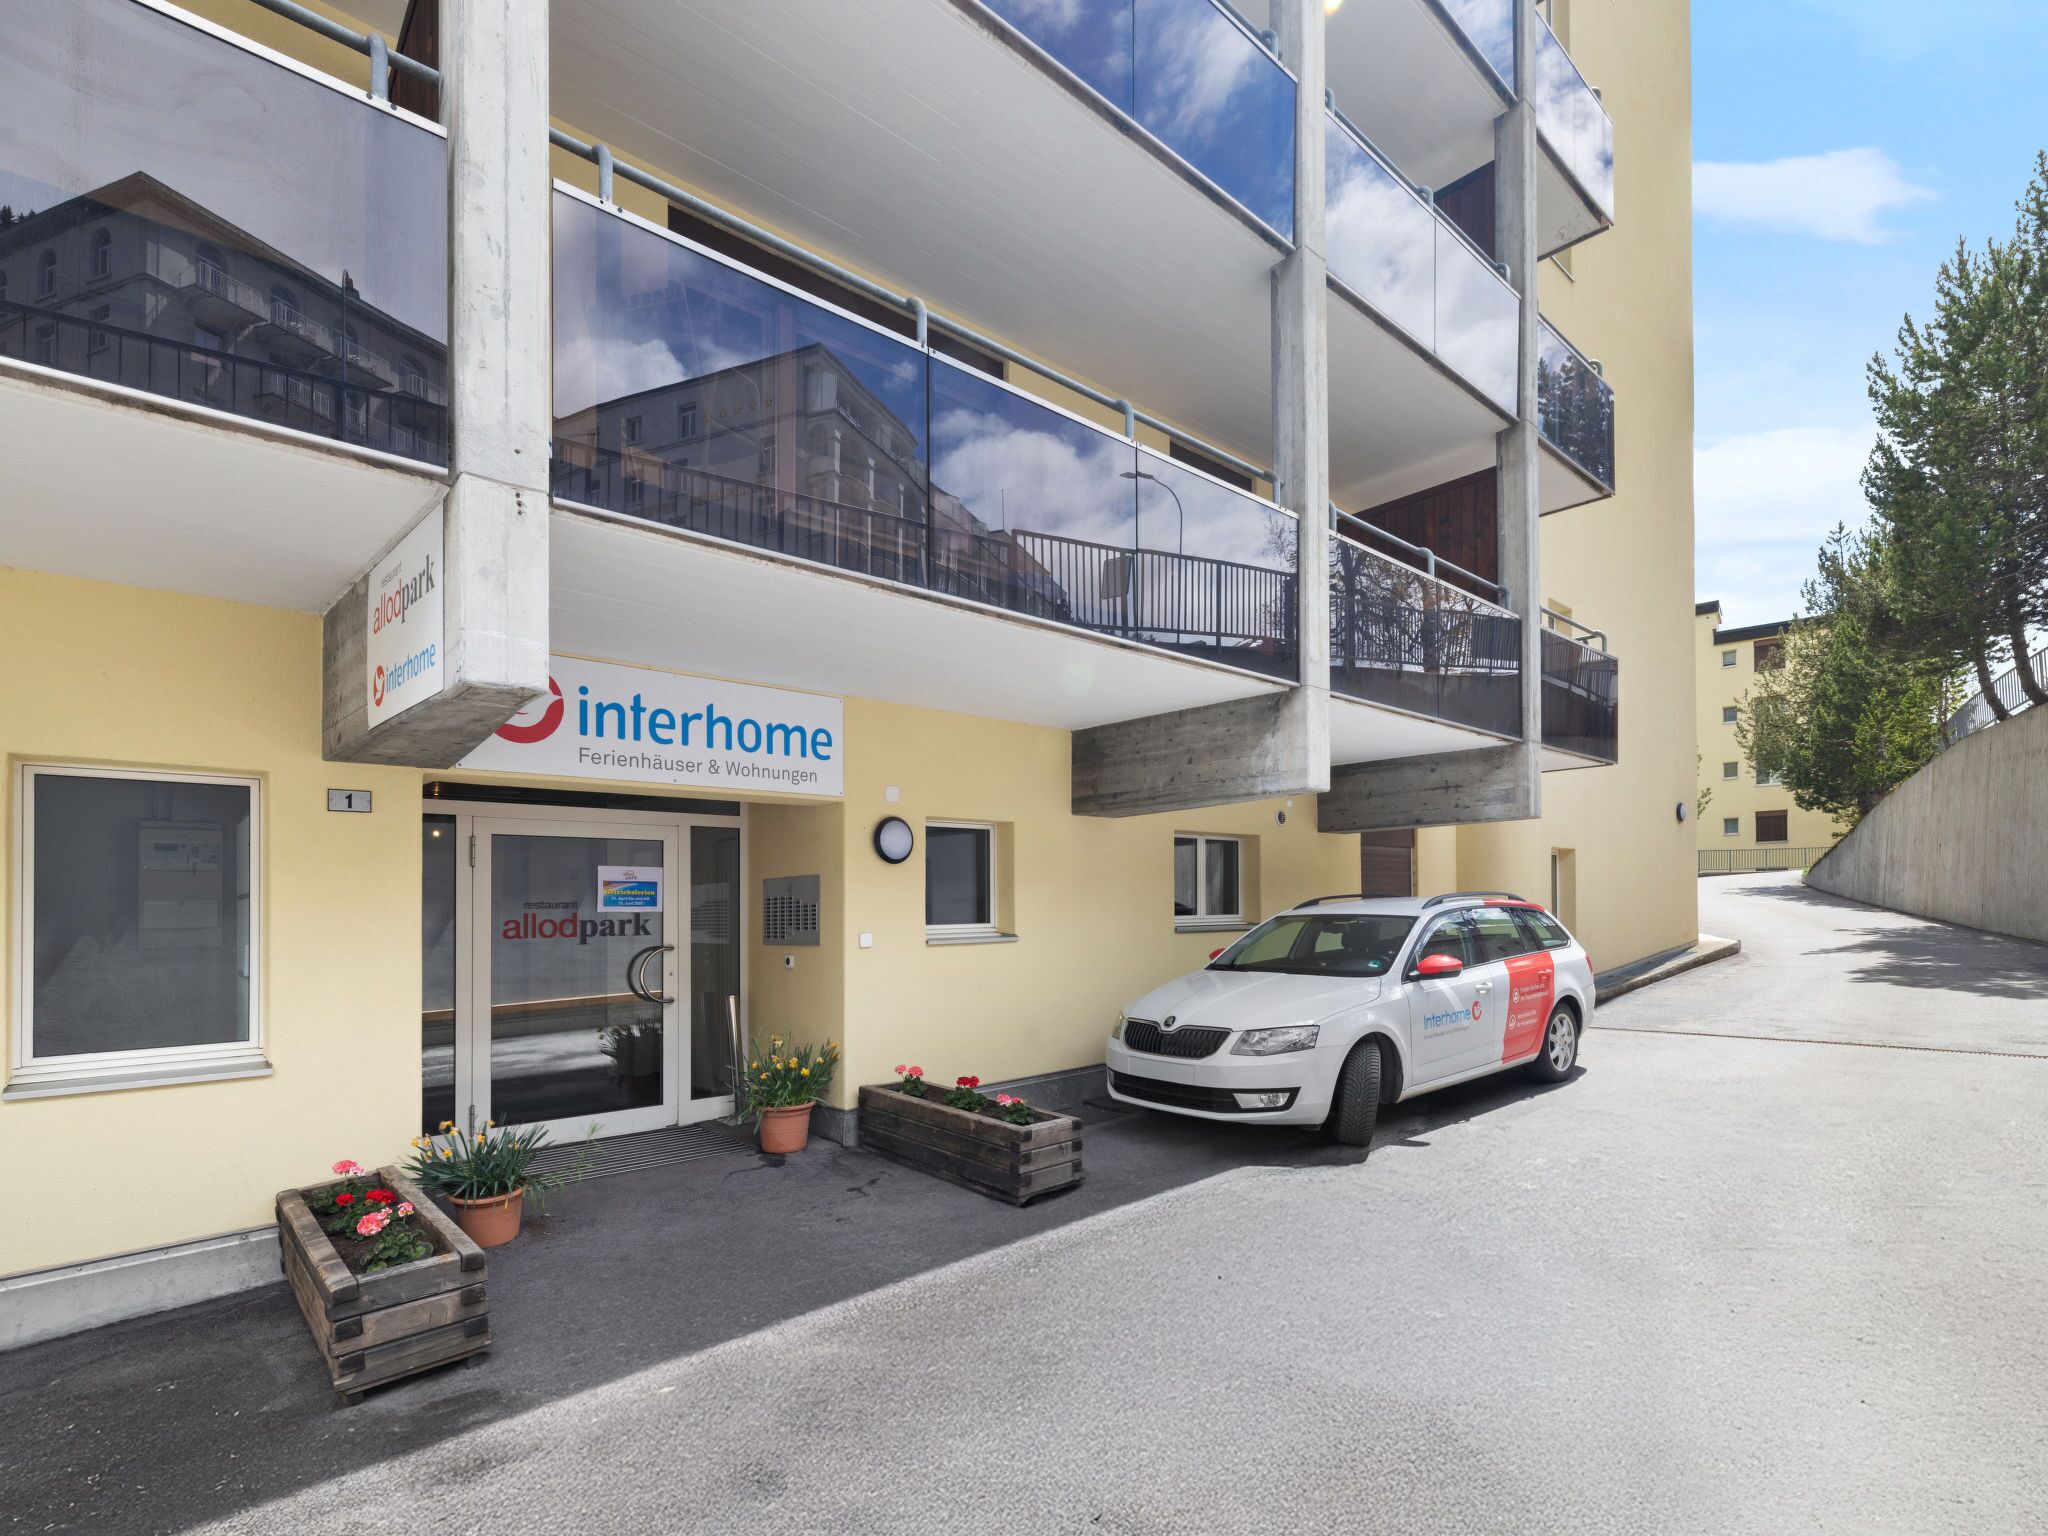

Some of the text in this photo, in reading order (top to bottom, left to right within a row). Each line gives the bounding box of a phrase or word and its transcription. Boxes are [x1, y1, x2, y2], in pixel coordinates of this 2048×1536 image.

[373, 553, 435, 635] allodpark
[385, 643, 436, 694] interhome
[578, 685, 833, 761] interhome
[578, 747, 818, 785] Ferienhäuser & Wohnungen
[345, 793, 353, 809] 1
[523, 901, 578, 910] restaurant
[502, 911, 652, 945] allodpark
[1423, 1009, 1471, 1030] Interhome
